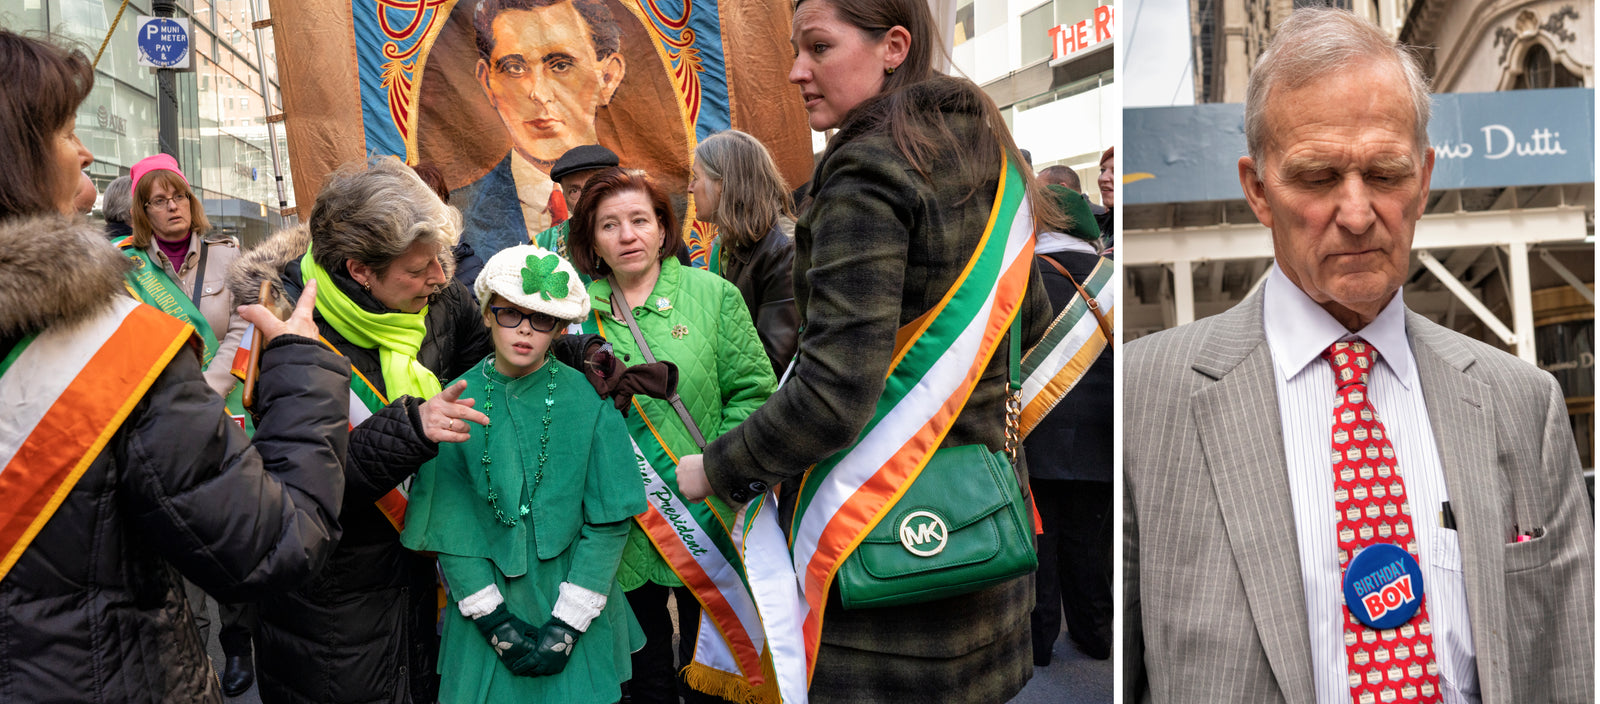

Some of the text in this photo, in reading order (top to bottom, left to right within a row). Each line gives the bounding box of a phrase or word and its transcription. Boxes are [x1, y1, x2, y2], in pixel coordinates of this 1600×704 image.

[147, 24, 158, 39] P
[155, 44, 172, 52] PAY
[1048, 5, 1114, 60] THE R
[1480, 124, 1567, 160] Dutti
[649, 486, 708, 557] President
[904, 521, 943, 546] MK
[1352, 557, 1407, 597] BIRTHDAY
[1362, 574, 1415, 621] BOY
